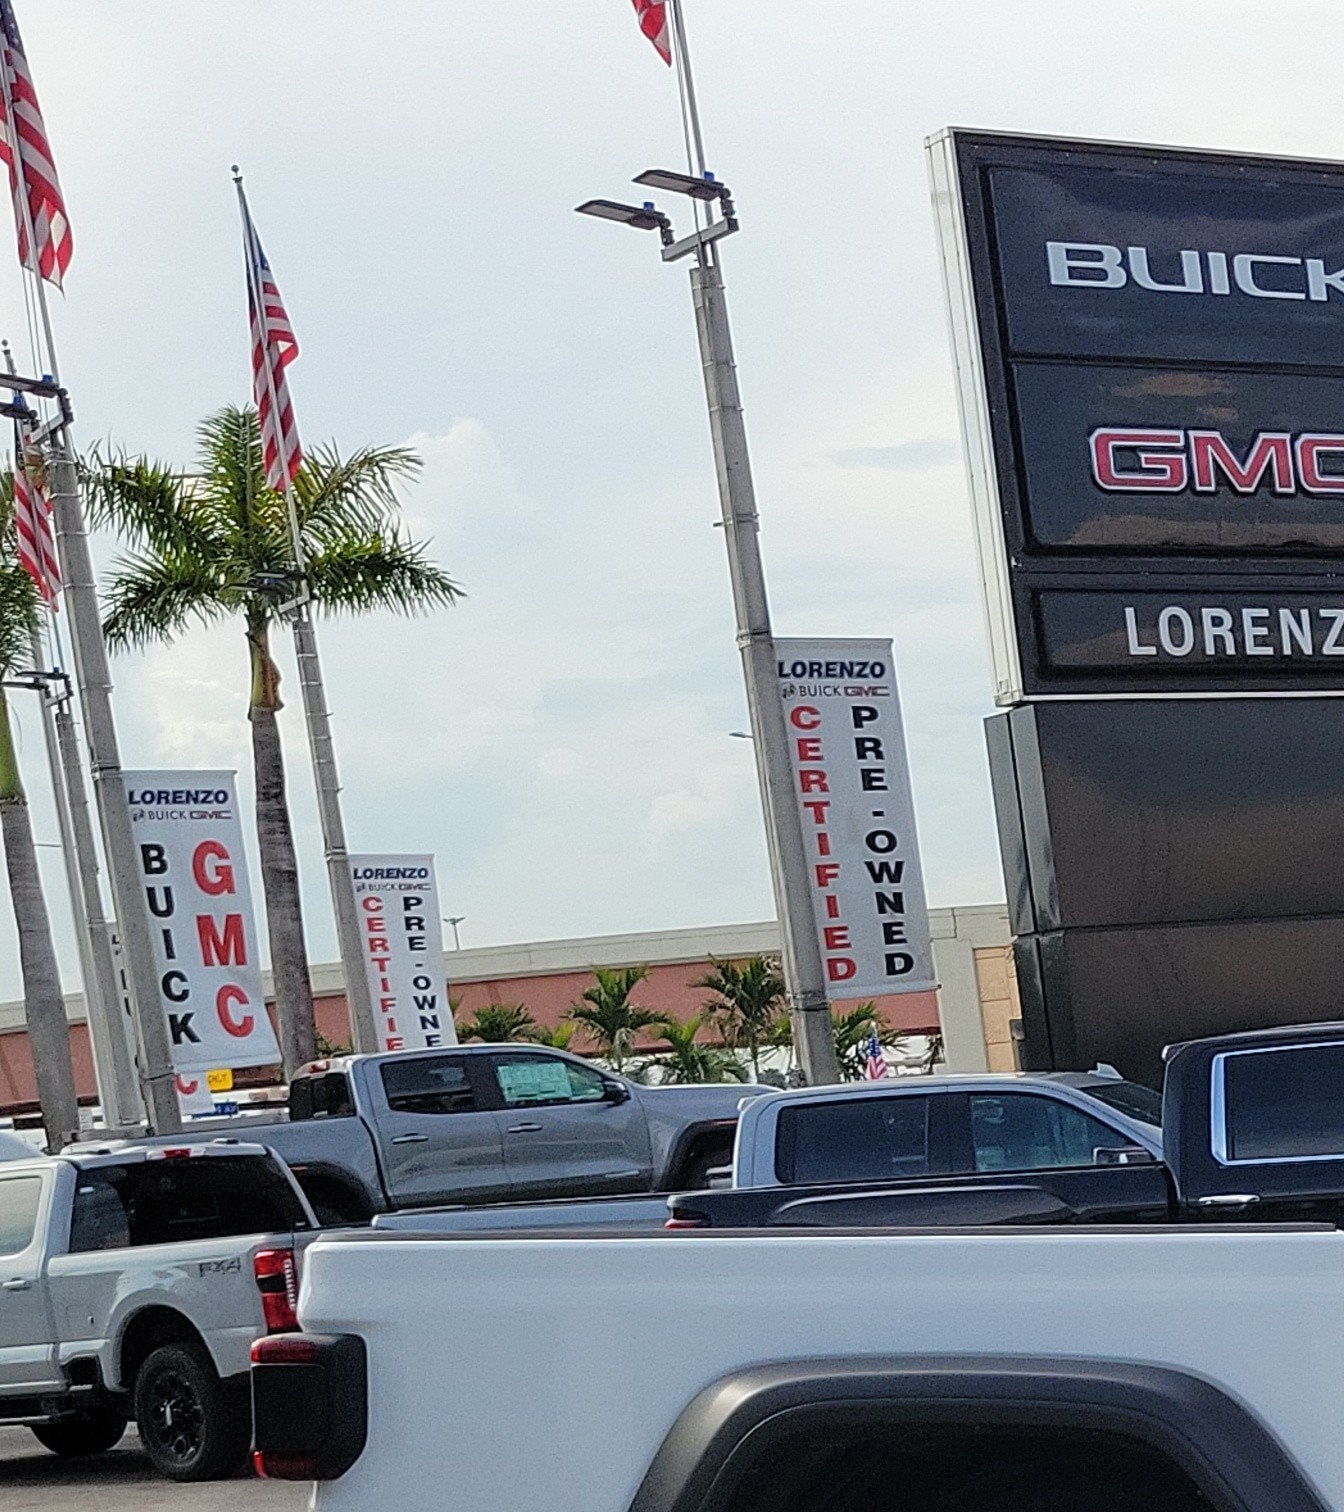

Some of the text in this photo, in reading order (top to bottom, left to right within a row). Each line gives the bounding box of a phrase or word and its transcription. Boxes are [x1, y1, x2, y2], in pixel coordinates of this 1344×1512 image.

[778, 661, 886, 679] LORENZO
[799, 685, 890, 697] BUICK GMC
[128, 789, 229, 806] LORENZO
[148, 810, 232, 821] BUICK GMC
[790, 705, 858, 981] CERTIFIED
[851, 705, 914, 976] PRE-OWNED
[140, 843, 202, 1045] BUICK
[192, 840, 254, 1038] GMC
[353, 867, 429, 880] LORENZO
[362, 896, 405, 1051] CERTIFIE
[403, 896, 443, 1047] PRE-OWNE
